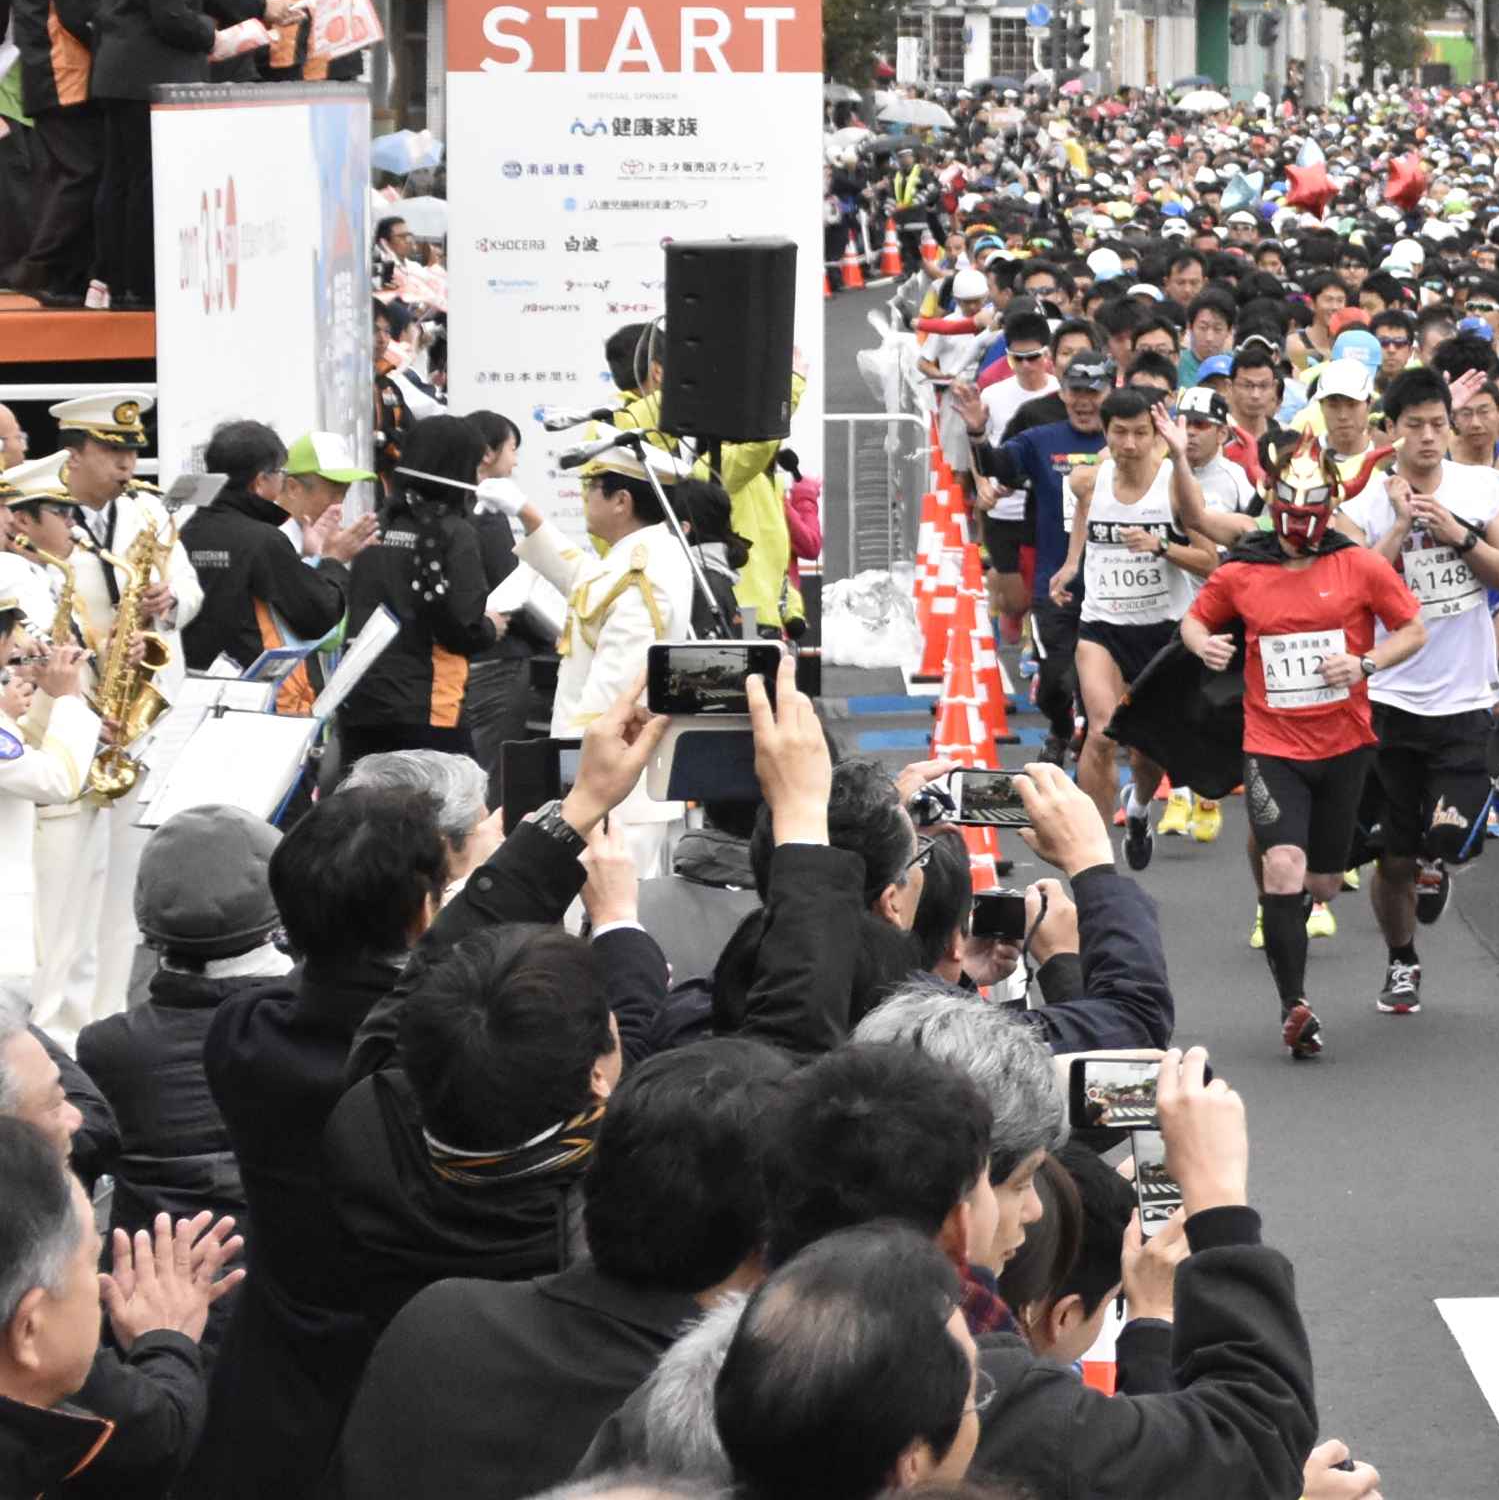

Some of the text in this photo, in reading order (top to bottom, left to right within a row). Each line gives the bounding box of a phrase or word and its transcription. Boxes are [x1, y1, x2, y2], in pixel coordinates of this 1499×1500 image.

[480, 5, 796, 73] START
[612, 117, 698, 137] 健康家族
[564, 236, 600, 252] 白波
[1099, 568, 1161, 588] A 1063
[1411, 578, 1421, 592] A
[1267, 654, 1328, 678] A 112
